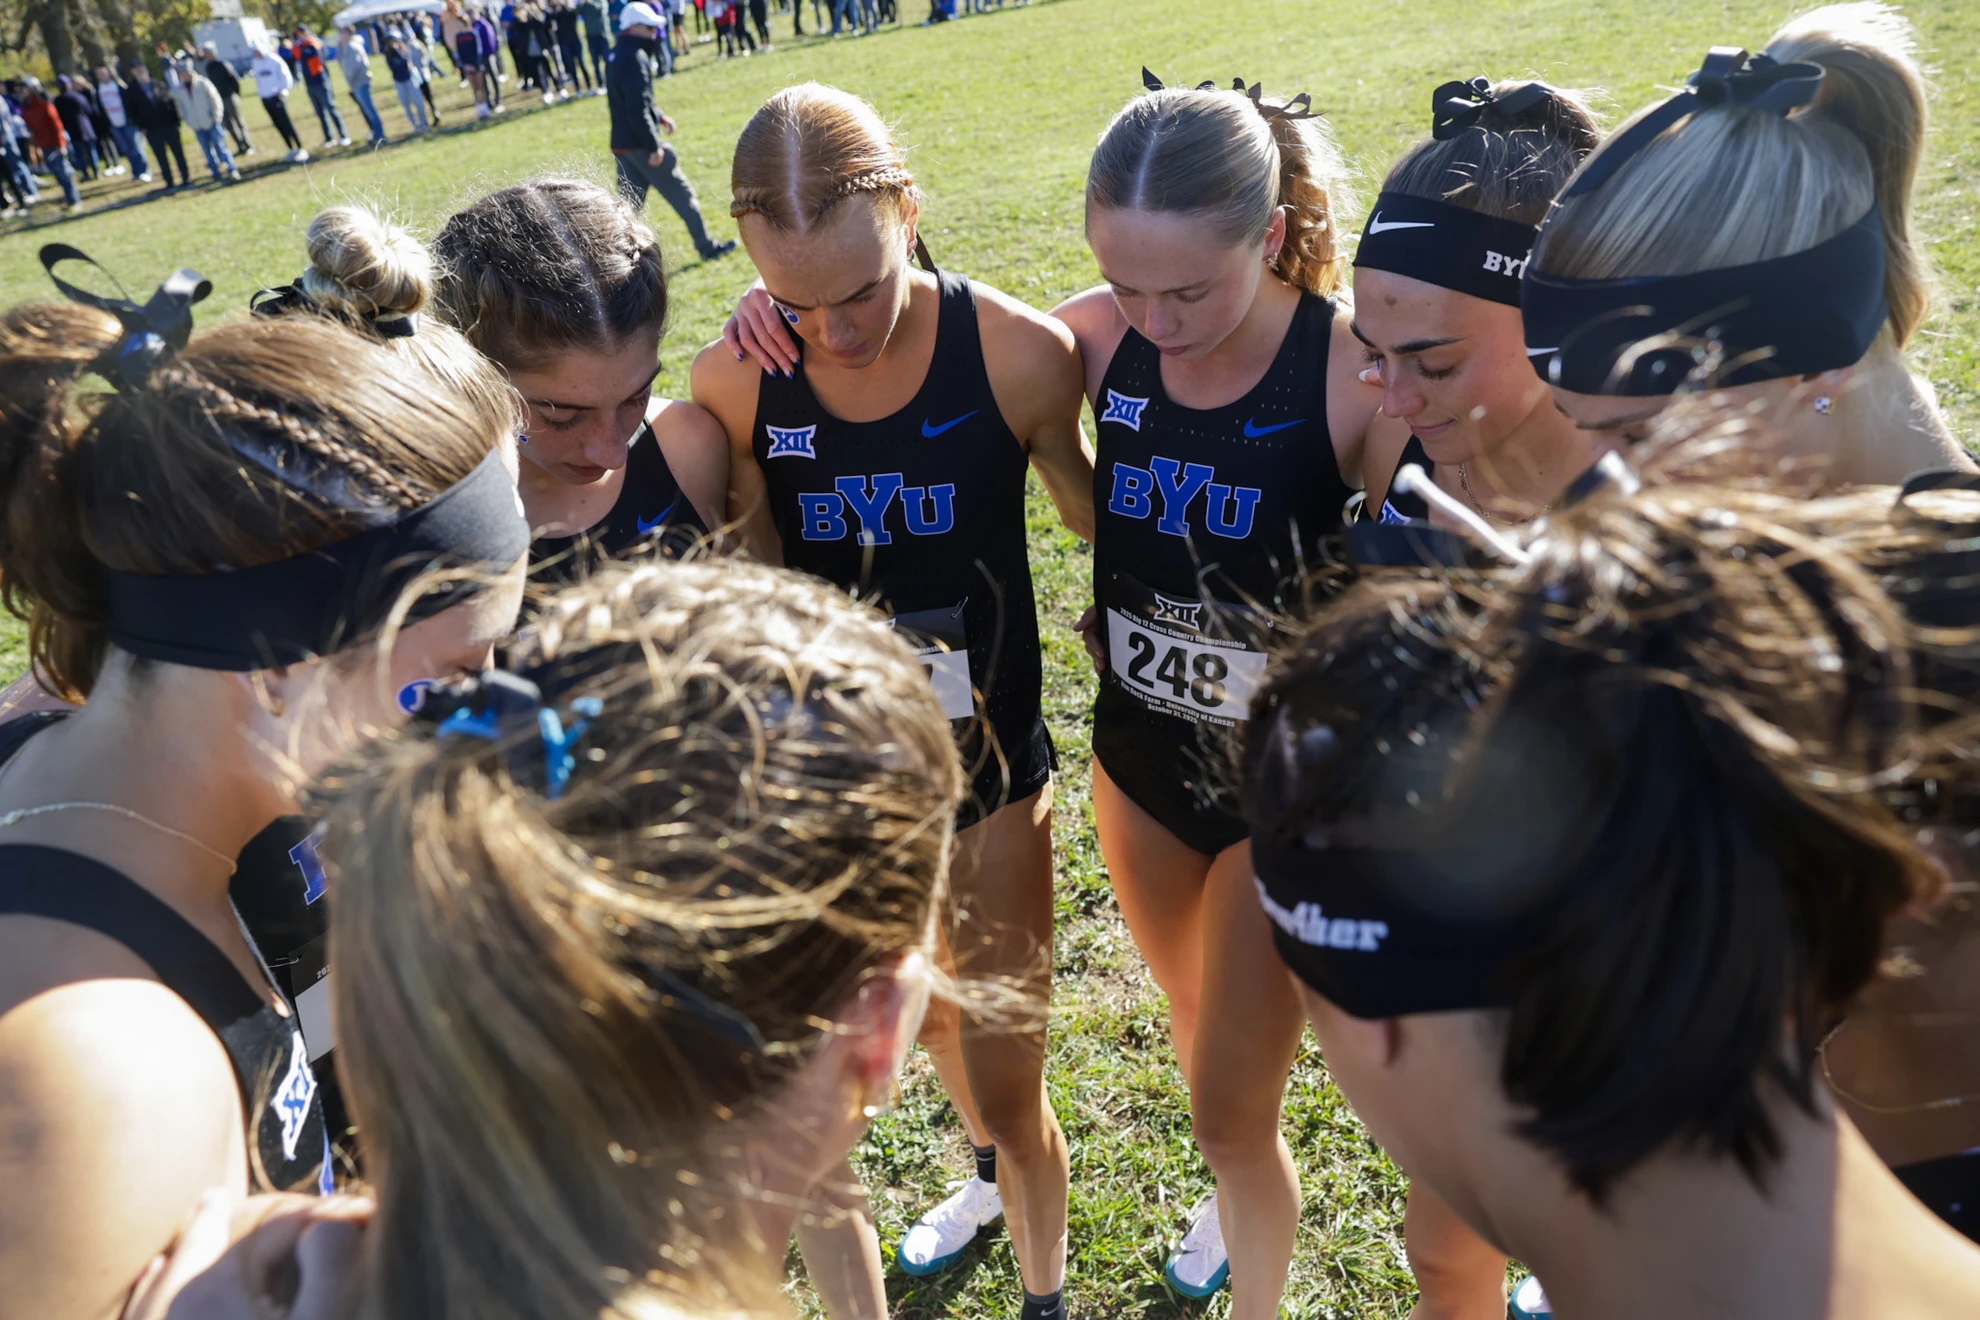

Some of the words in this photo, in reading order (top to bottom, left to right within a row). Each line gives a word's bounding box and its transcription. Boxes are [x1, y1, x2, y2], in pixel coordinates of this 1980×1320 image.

[768, 427, 814, 456] XII
[798, 472, 955, 546] BYU
[1108, 455, 1261, 539] BYU
[1142, 619, 1149, 628] 12
[1149, 622, 1167, 634] Cross
[1168, 629, 1195, 641] Country
[1195, 635, 1246, 650] Championship
[1128, 631, 1228, 708] 248
[1147, 703, 1173, 715] October
[1166, 701, 1200, 719] University
[1208, 715, 1236, 727] Kansas
